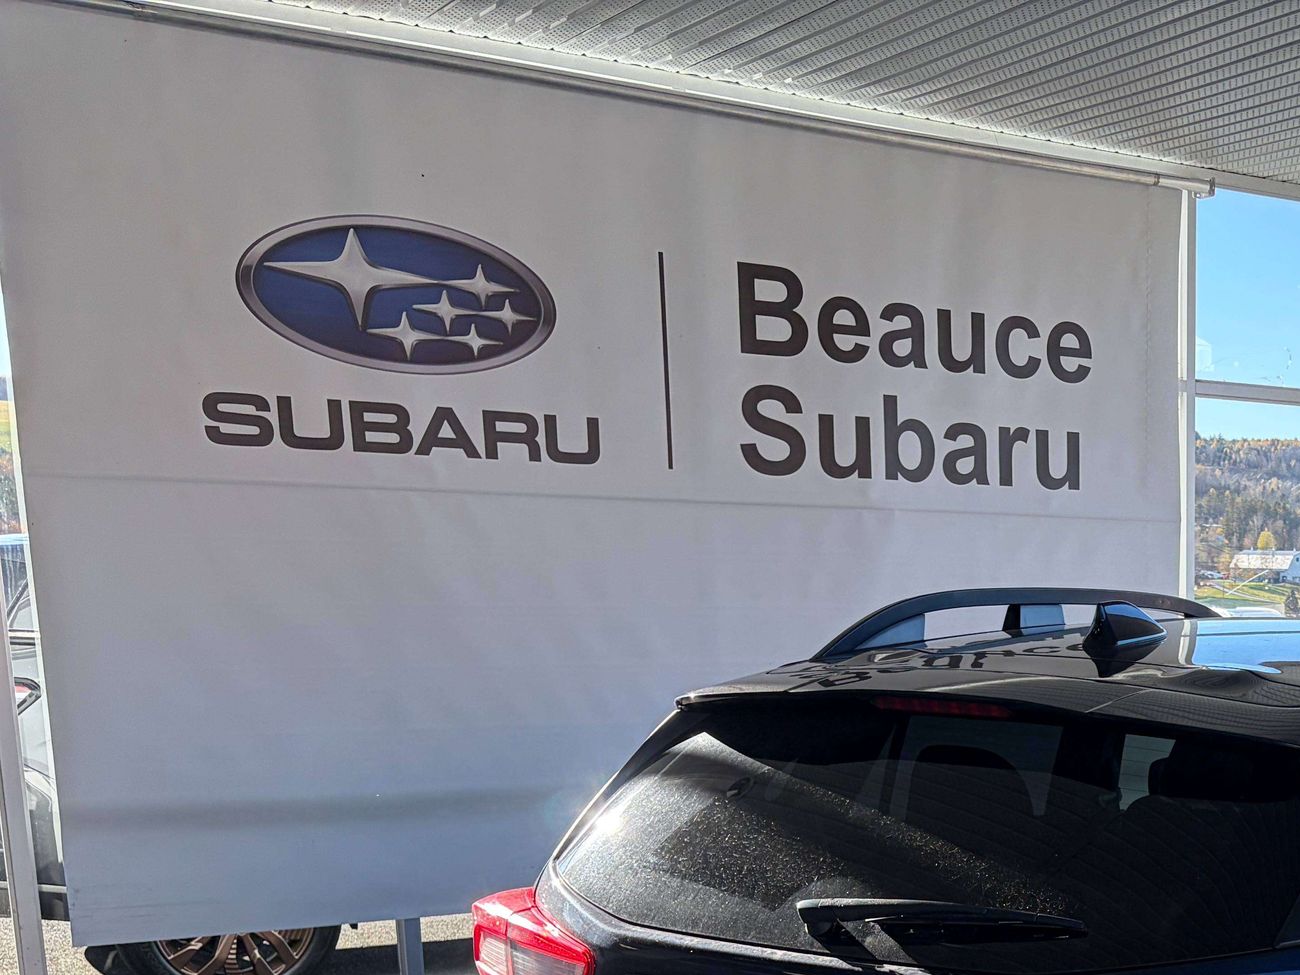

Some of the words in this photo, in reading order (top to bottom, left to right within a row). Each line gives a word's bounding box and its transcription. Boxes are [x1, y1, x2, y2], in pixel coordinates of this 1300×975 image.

[737, 261, 1093, 384] Beauce
[202, 391, 601, 465] SUBARU
[739, 384, 1081, 491] Subaru
